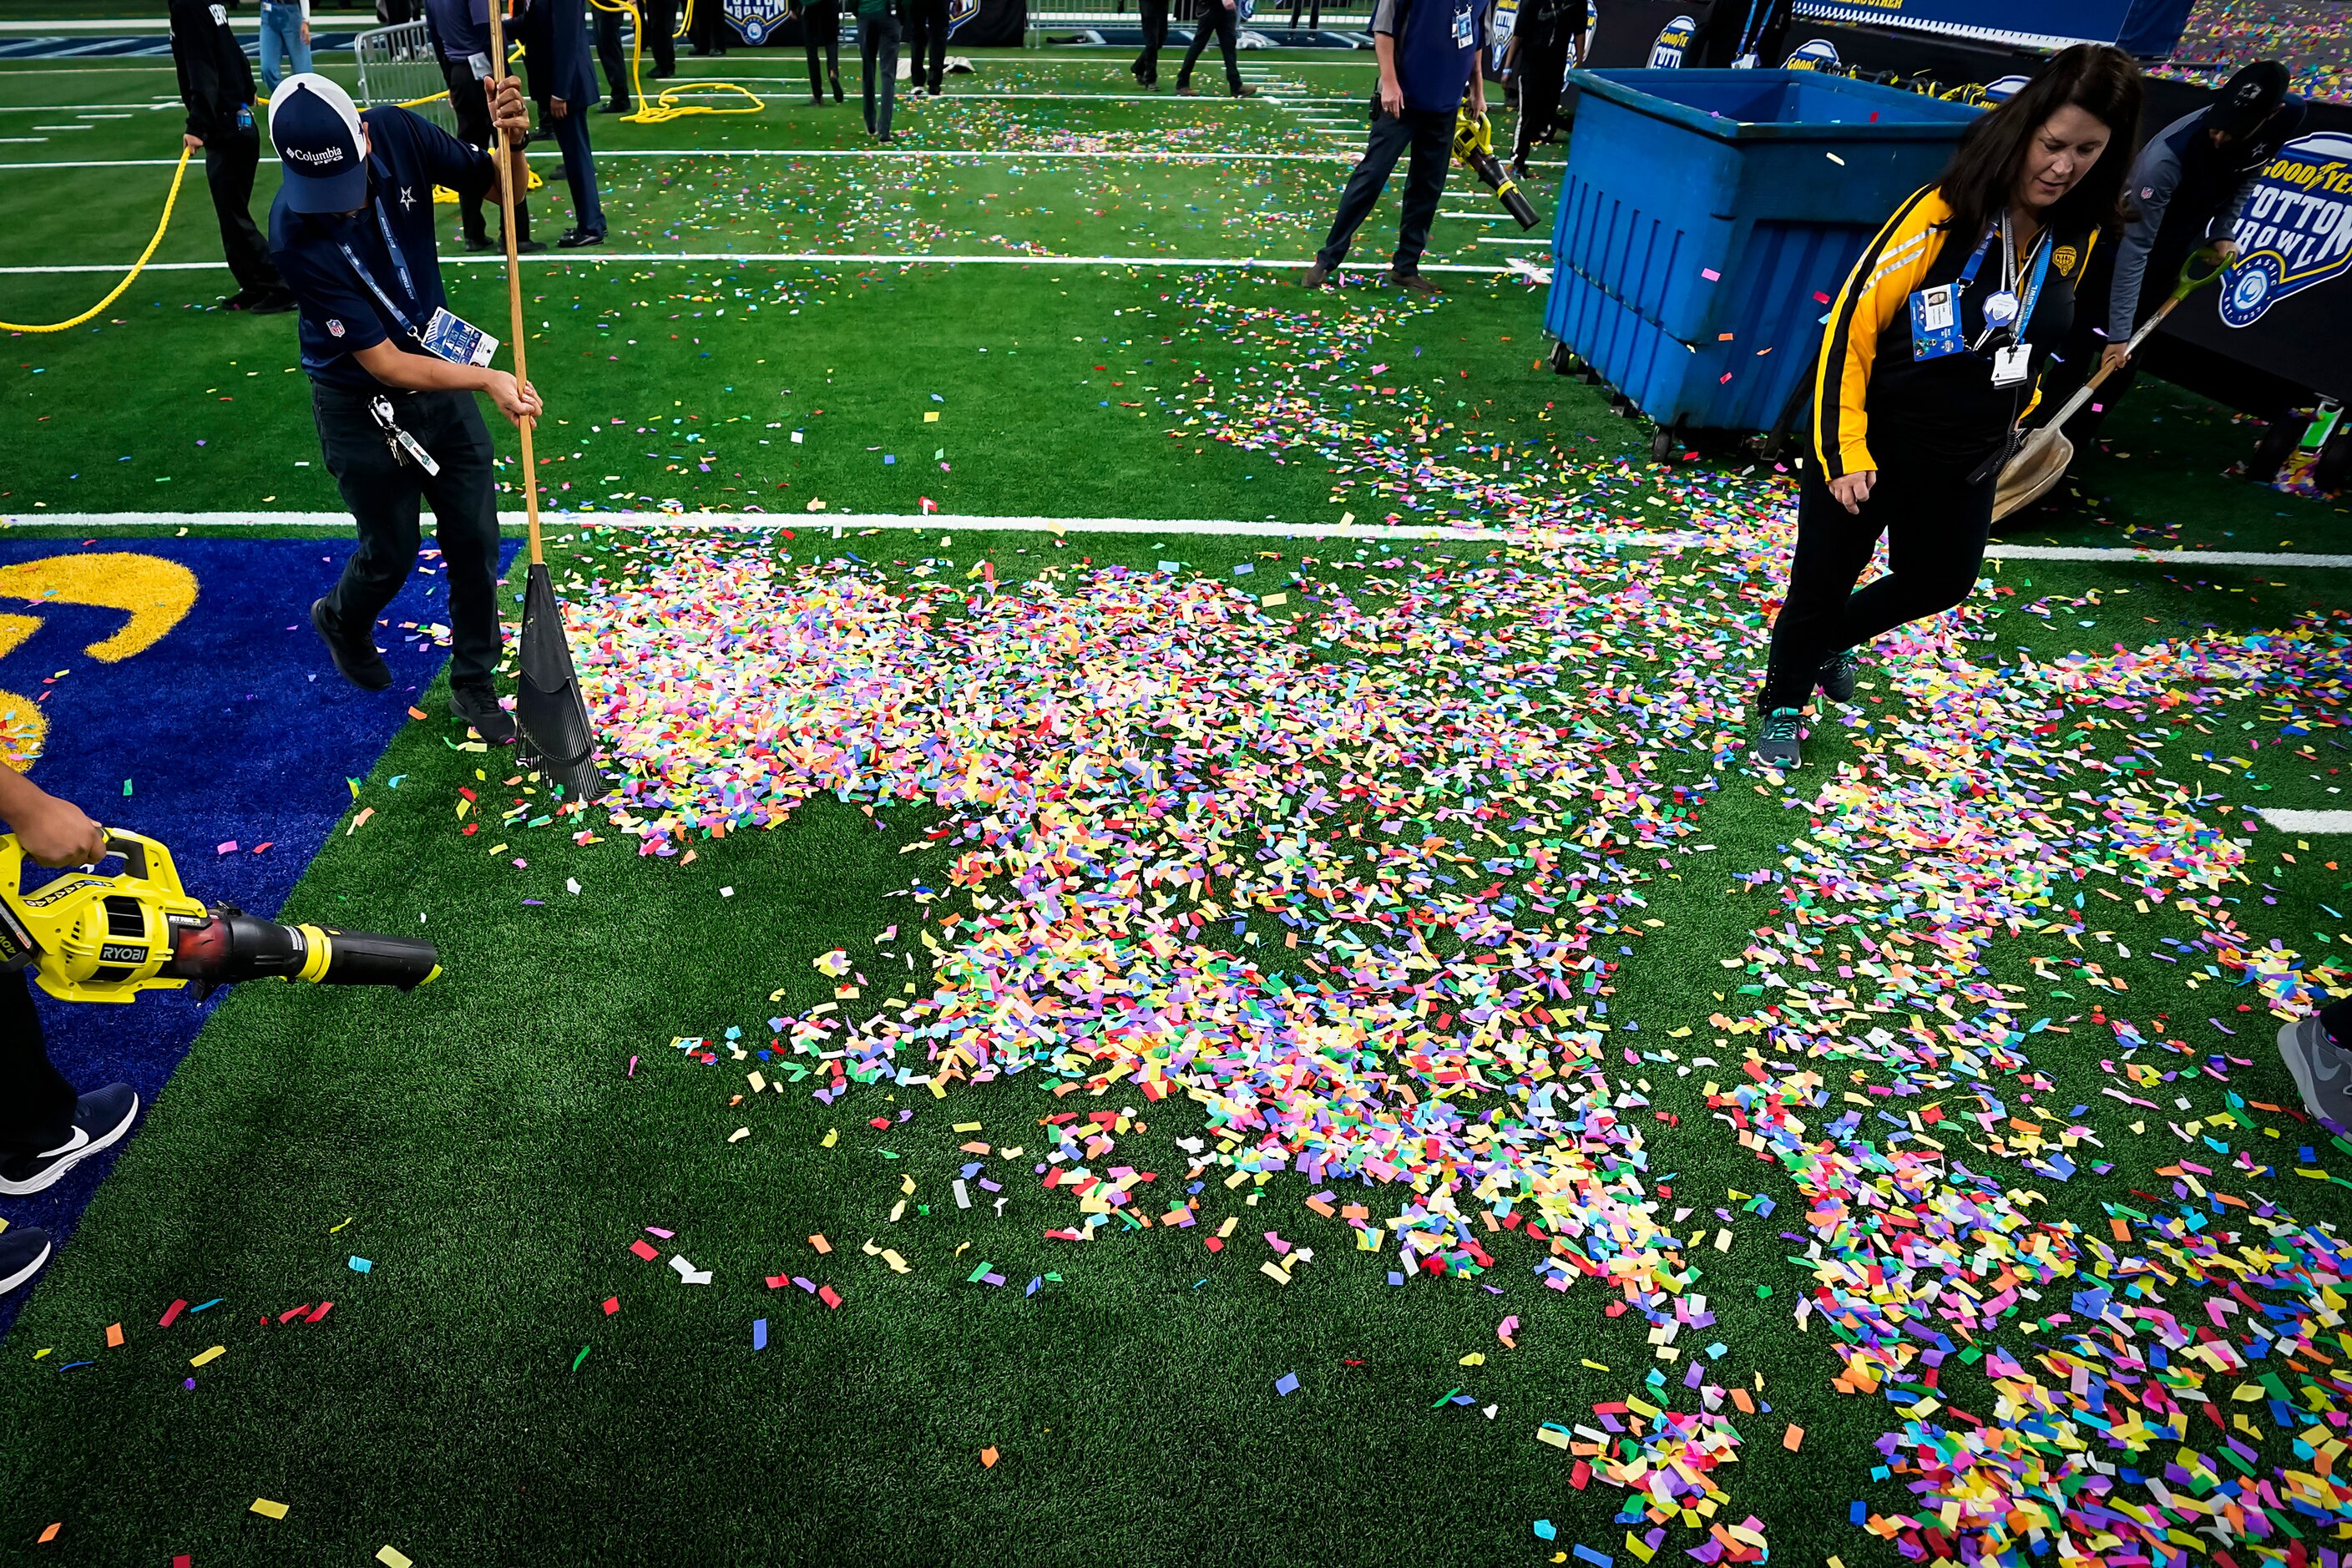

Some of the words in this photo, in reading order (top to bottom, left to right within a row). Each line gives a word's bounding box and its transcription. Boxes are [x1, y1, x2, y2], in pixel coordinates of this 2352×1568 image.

[735, 6, 774, 20] BOWL
[295, 146, 342, 162] Columbia
[2234, 220, 2314, 270] BOWL
[2237, 258, 2278, 286] CLASSIC
[445, 328, 459, 350] AT&T
[449, 325, 473, 362] STADIUM
[103, 947, 145, 961] RYOBI
